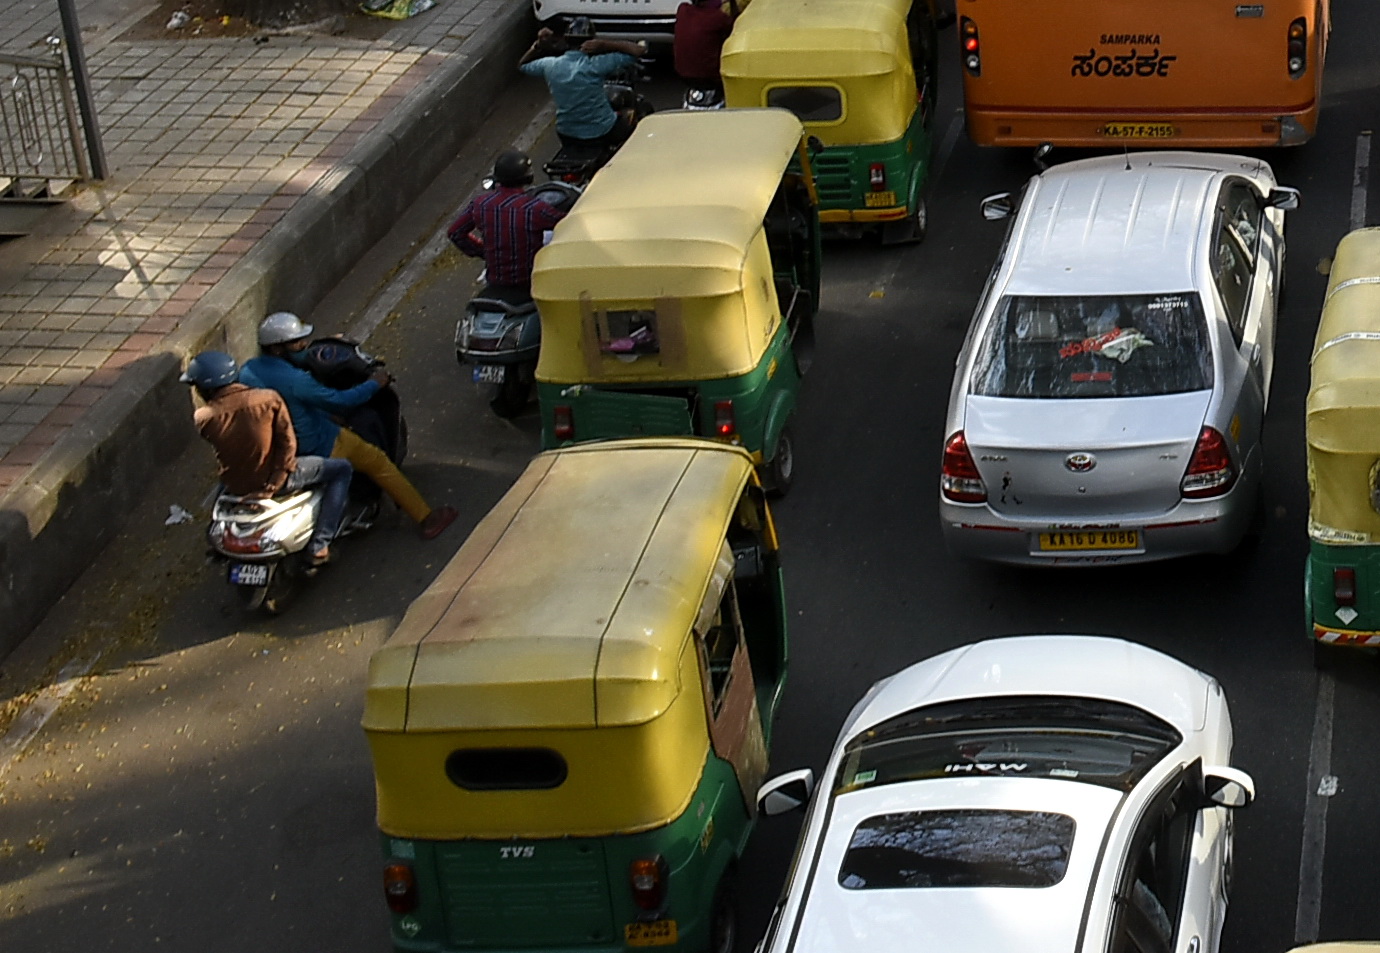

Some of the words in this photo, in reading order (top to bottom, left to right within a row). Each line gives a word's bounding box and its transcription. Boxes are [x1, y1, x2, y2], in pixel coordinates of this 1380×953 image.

[1100, 34, 1161, 45] SAMPARKA
[1071, 48, 1177, 77] ಸಂಪರ್ಕ
[1100, 531, 1135, 545] 4086
[500, 846, 536, 859] TVS
